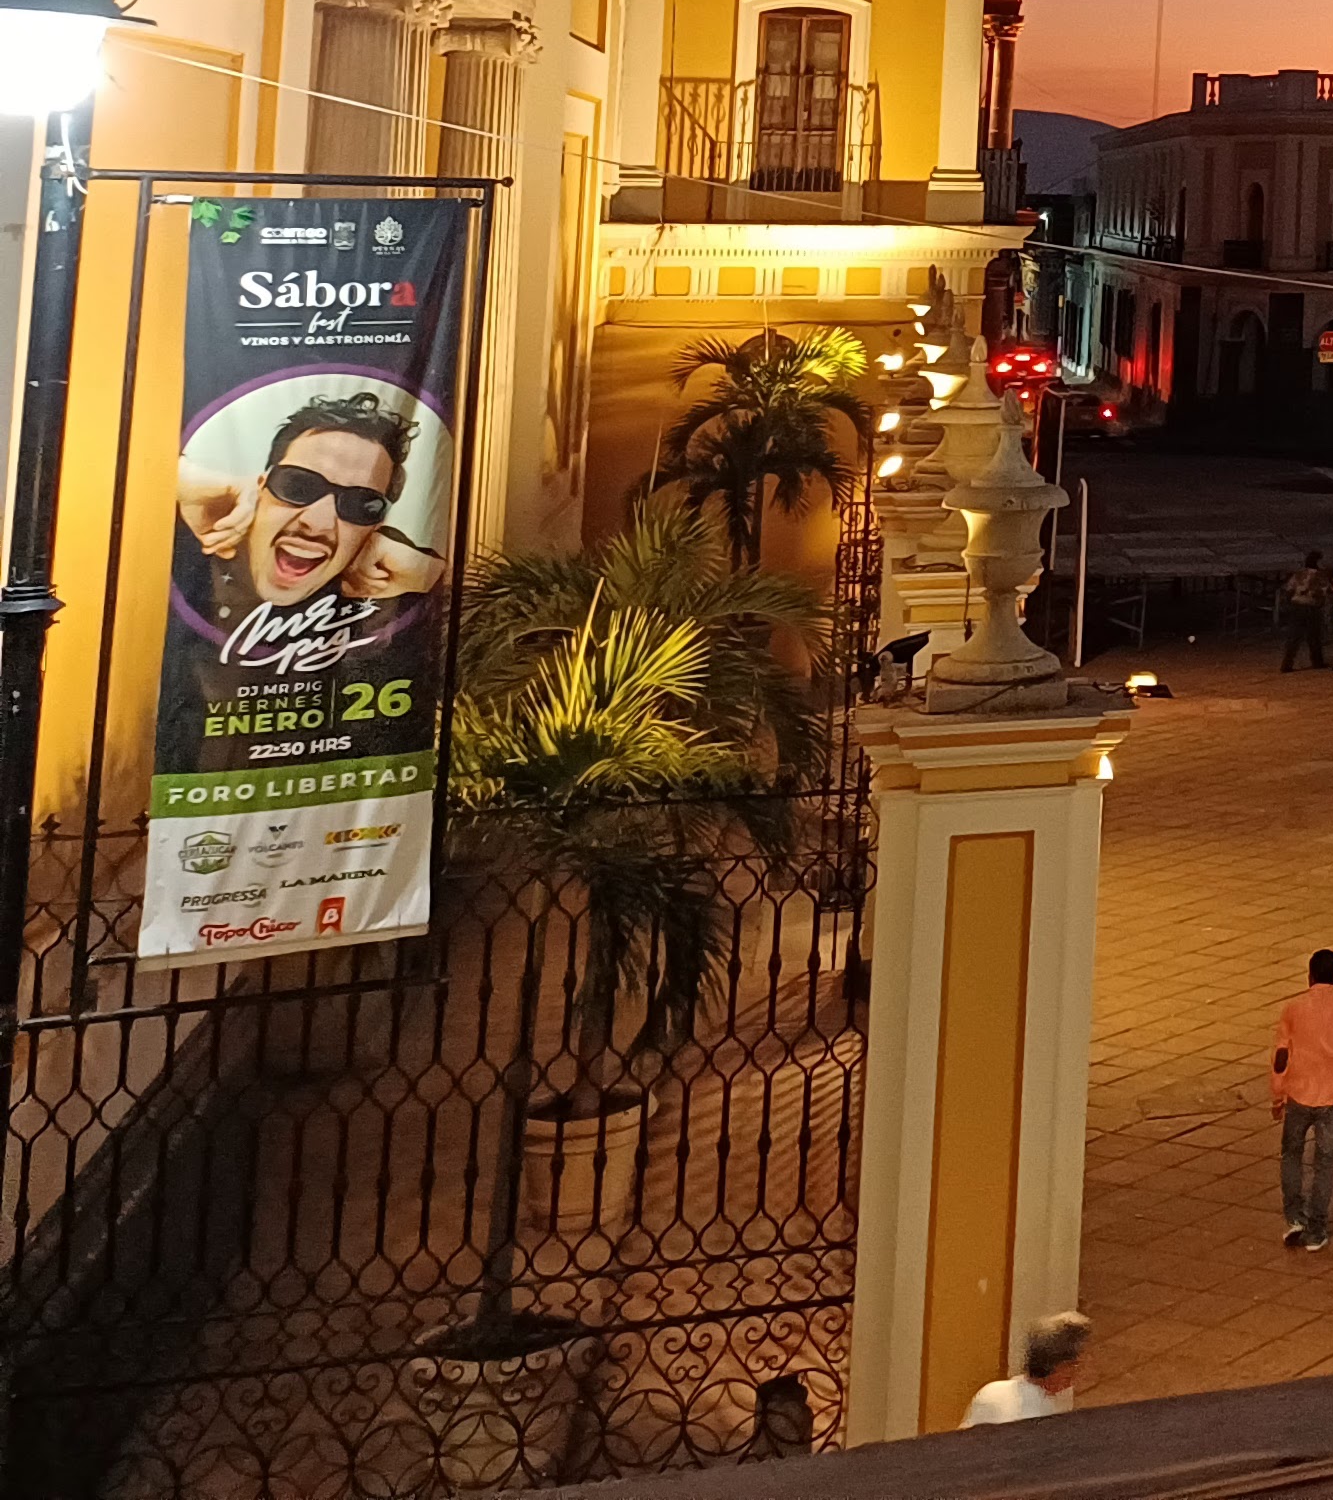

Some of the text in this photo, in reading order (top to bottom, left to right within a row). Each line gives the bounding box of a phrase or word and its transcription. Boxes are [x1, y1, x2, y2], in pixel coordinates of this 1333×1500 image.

[239, 269, 417, 309] Sábora
[308, 306, 353, 333] fest
[241, 332, 412, 347] VINOS Y GASTRONOMÍA
[237, 680, 323, 698] DJ MR PIG
[341, 679, 414, 722] 26
[208, 694, 322, 714] VIERNES
[204, 709, 325, 737] ENERO
[249, 735, 352, 760] 22:30 HRS
[168, 765, 418, 805] FORO LIBERTAD
[279, 878, 304, 889] LA
[181, 888, 267, 908] PROGRESSA
[199, 917, 301, 946] Topo Chico
